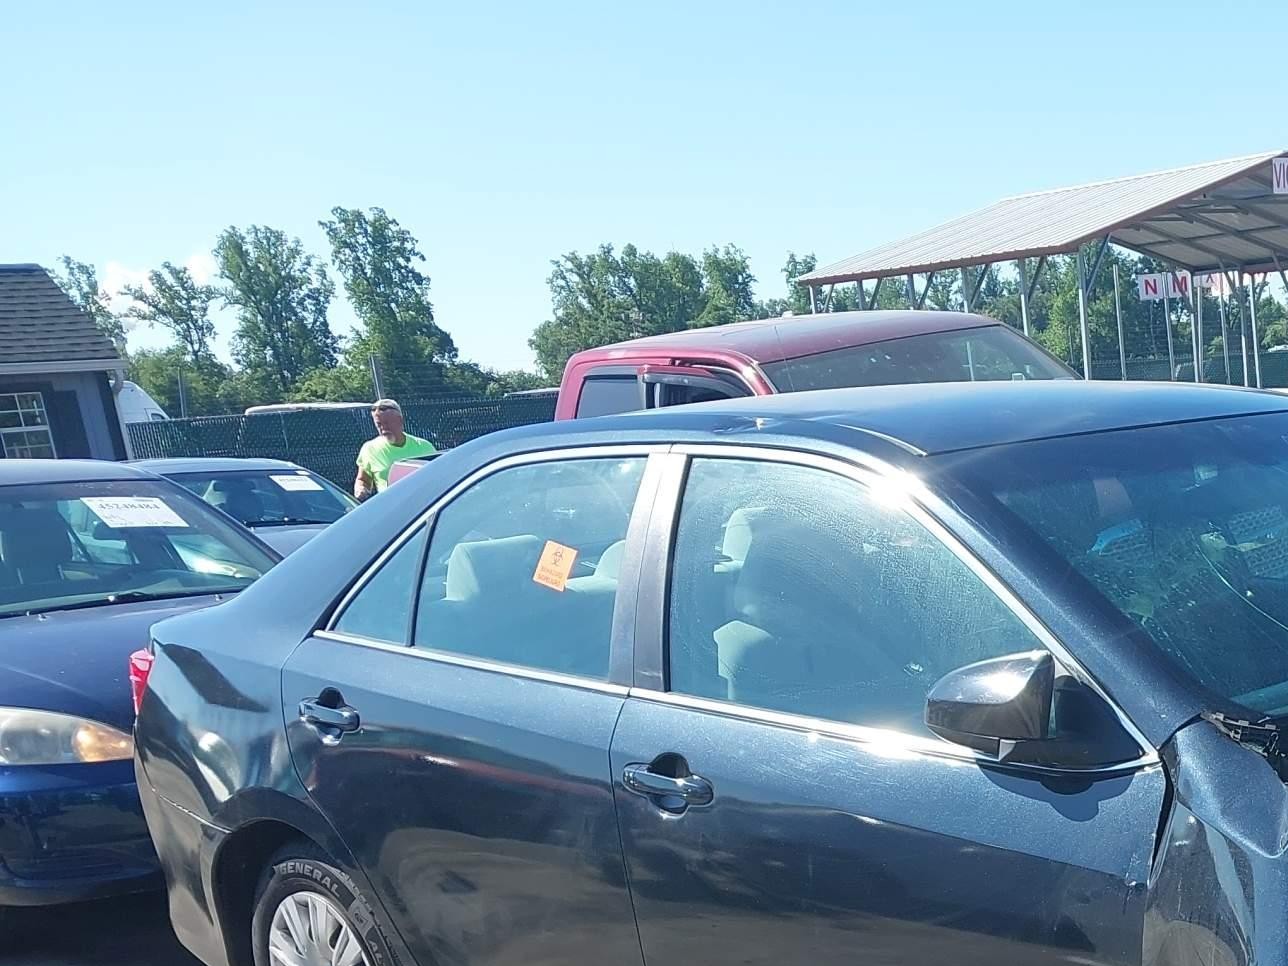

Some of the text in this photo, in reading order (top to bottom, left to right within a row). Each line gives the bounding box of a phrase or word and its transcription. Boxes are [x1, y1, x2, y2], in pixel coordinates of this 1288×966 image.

[1144, 278, 1158, 295] N
[1172, 275, 1188, 293] M
[279, 861, 343, 898] GENERAL
